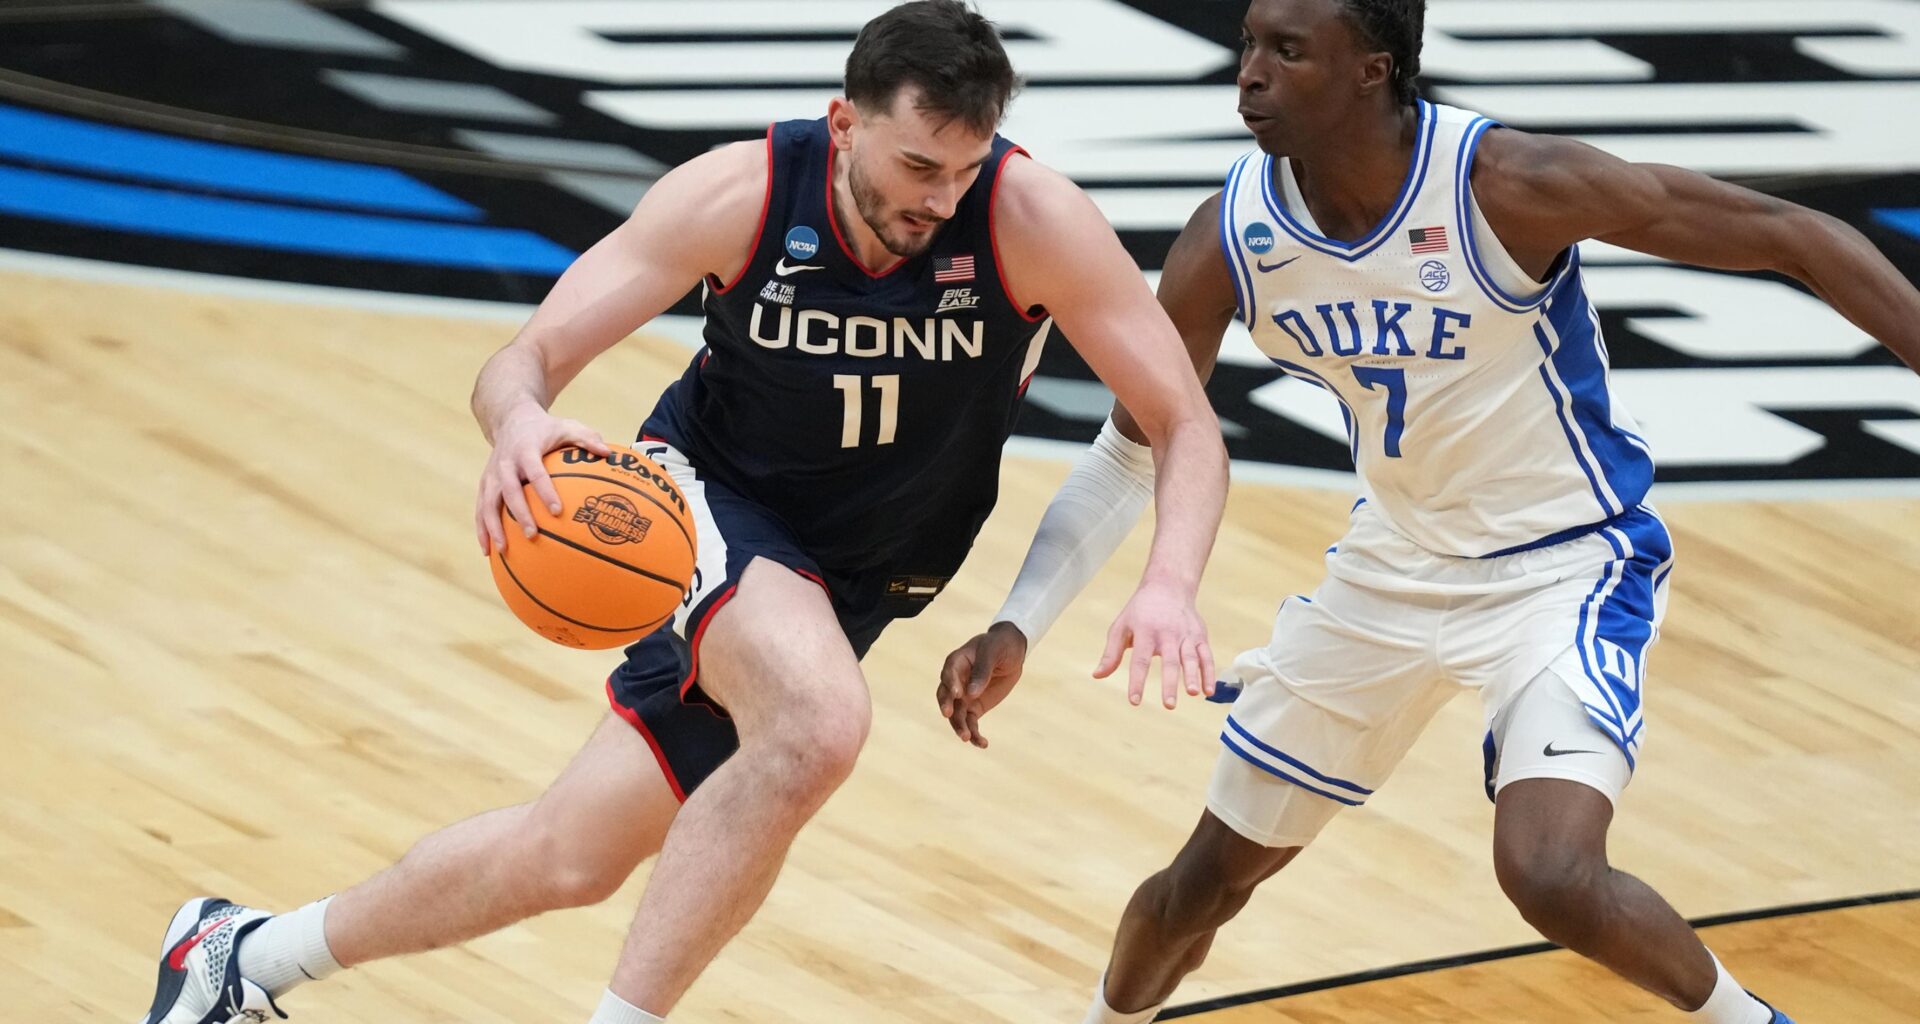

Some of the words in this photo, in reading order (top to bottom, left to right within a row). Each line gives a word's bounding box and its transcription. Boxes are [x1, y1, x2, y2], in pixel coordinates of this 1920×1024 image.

[789, 240, 817, 254] NCAA
[1248, 236, 1272, 247] NCAA
[1424, 270, 1447, 278] ACC
[760, 287, 796, 305] CHANGE
[765, 280, 779, 292] BE
[780, 284, 797, 295] THE
[942, 288, 972, 299] BIG
[938, 296, 981, 308] EAST
[749, 302, 984, 361] UCONN
[1271, 299, 1472, 361] DUKE
[833, 374, 900, 449] 11
[1350, 364, 1408, 458] 7
[595, 500, 634, 523] MARCH
[597, 511, 646, 543] MADNESS
